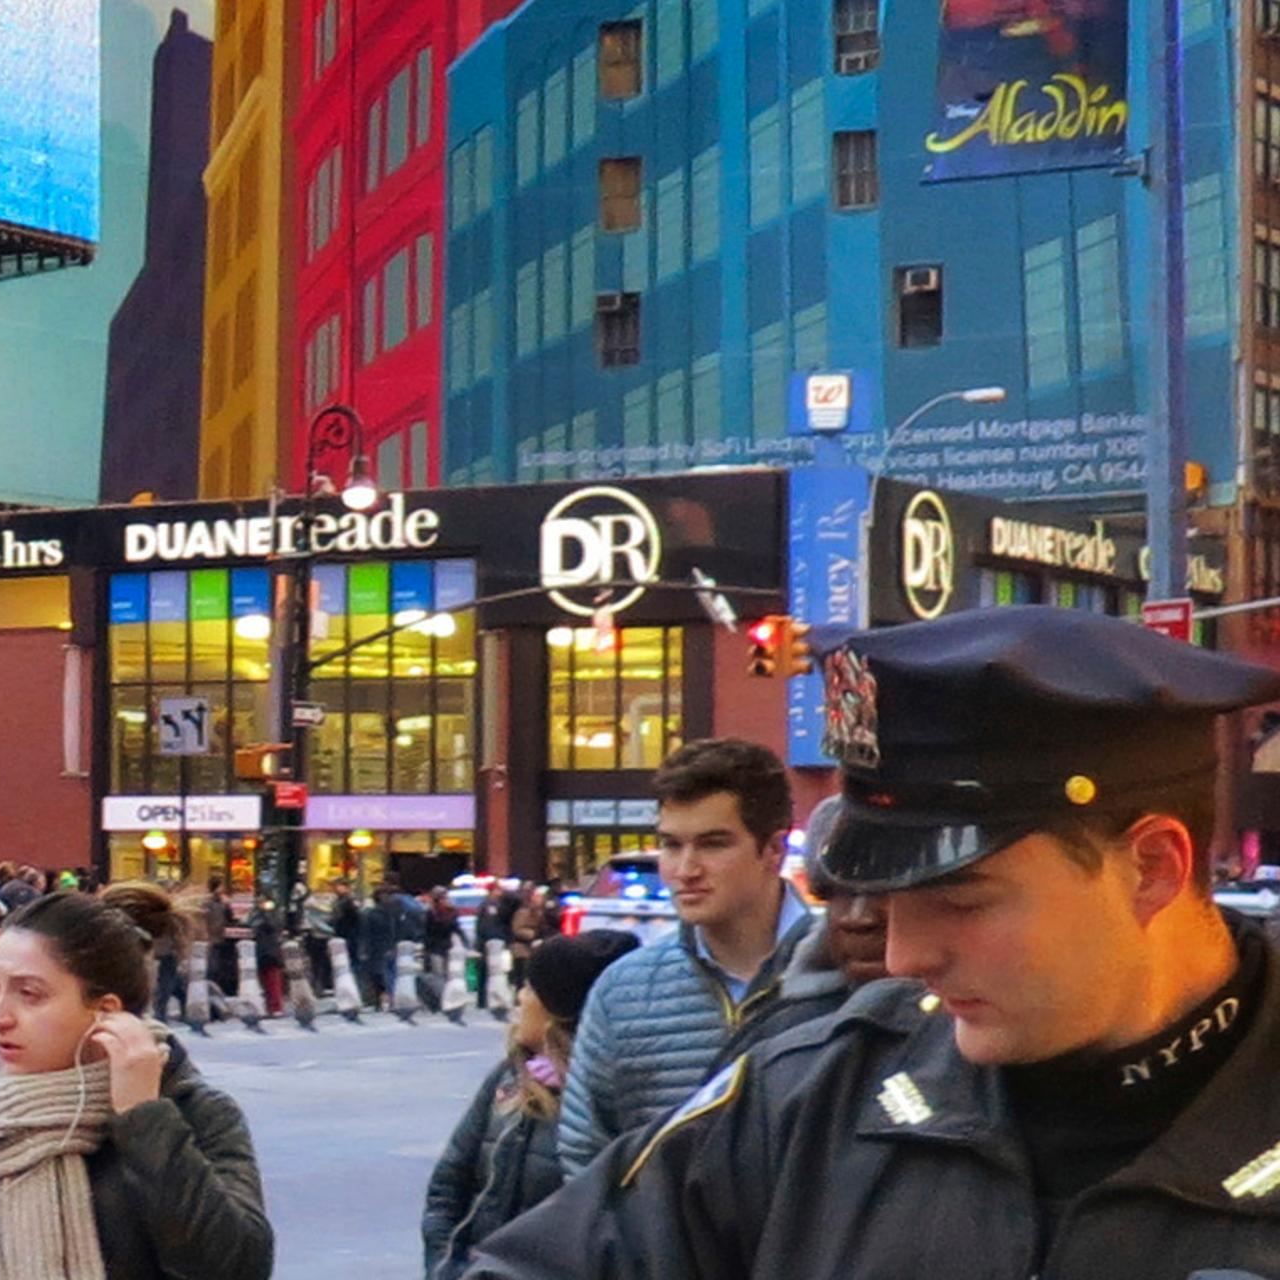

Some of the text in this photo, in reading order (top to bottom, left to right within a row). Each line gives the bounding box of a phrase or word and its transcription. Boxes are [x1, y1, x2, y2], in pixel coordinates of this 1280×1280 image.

[925, 72, 1130, 154] Aladdin
[978, 416, 1076, 441] Mortgage
[1081, 412, 1147, 434] Banke
[1061, 463, 1097, 485] CA
[124, 492, 440, 563] DUANE reade
[540, 514, 649, 588] DR
[991, 516, 1054, 565] DUANE
[1121, 996, 1240, 1087] NYPD
